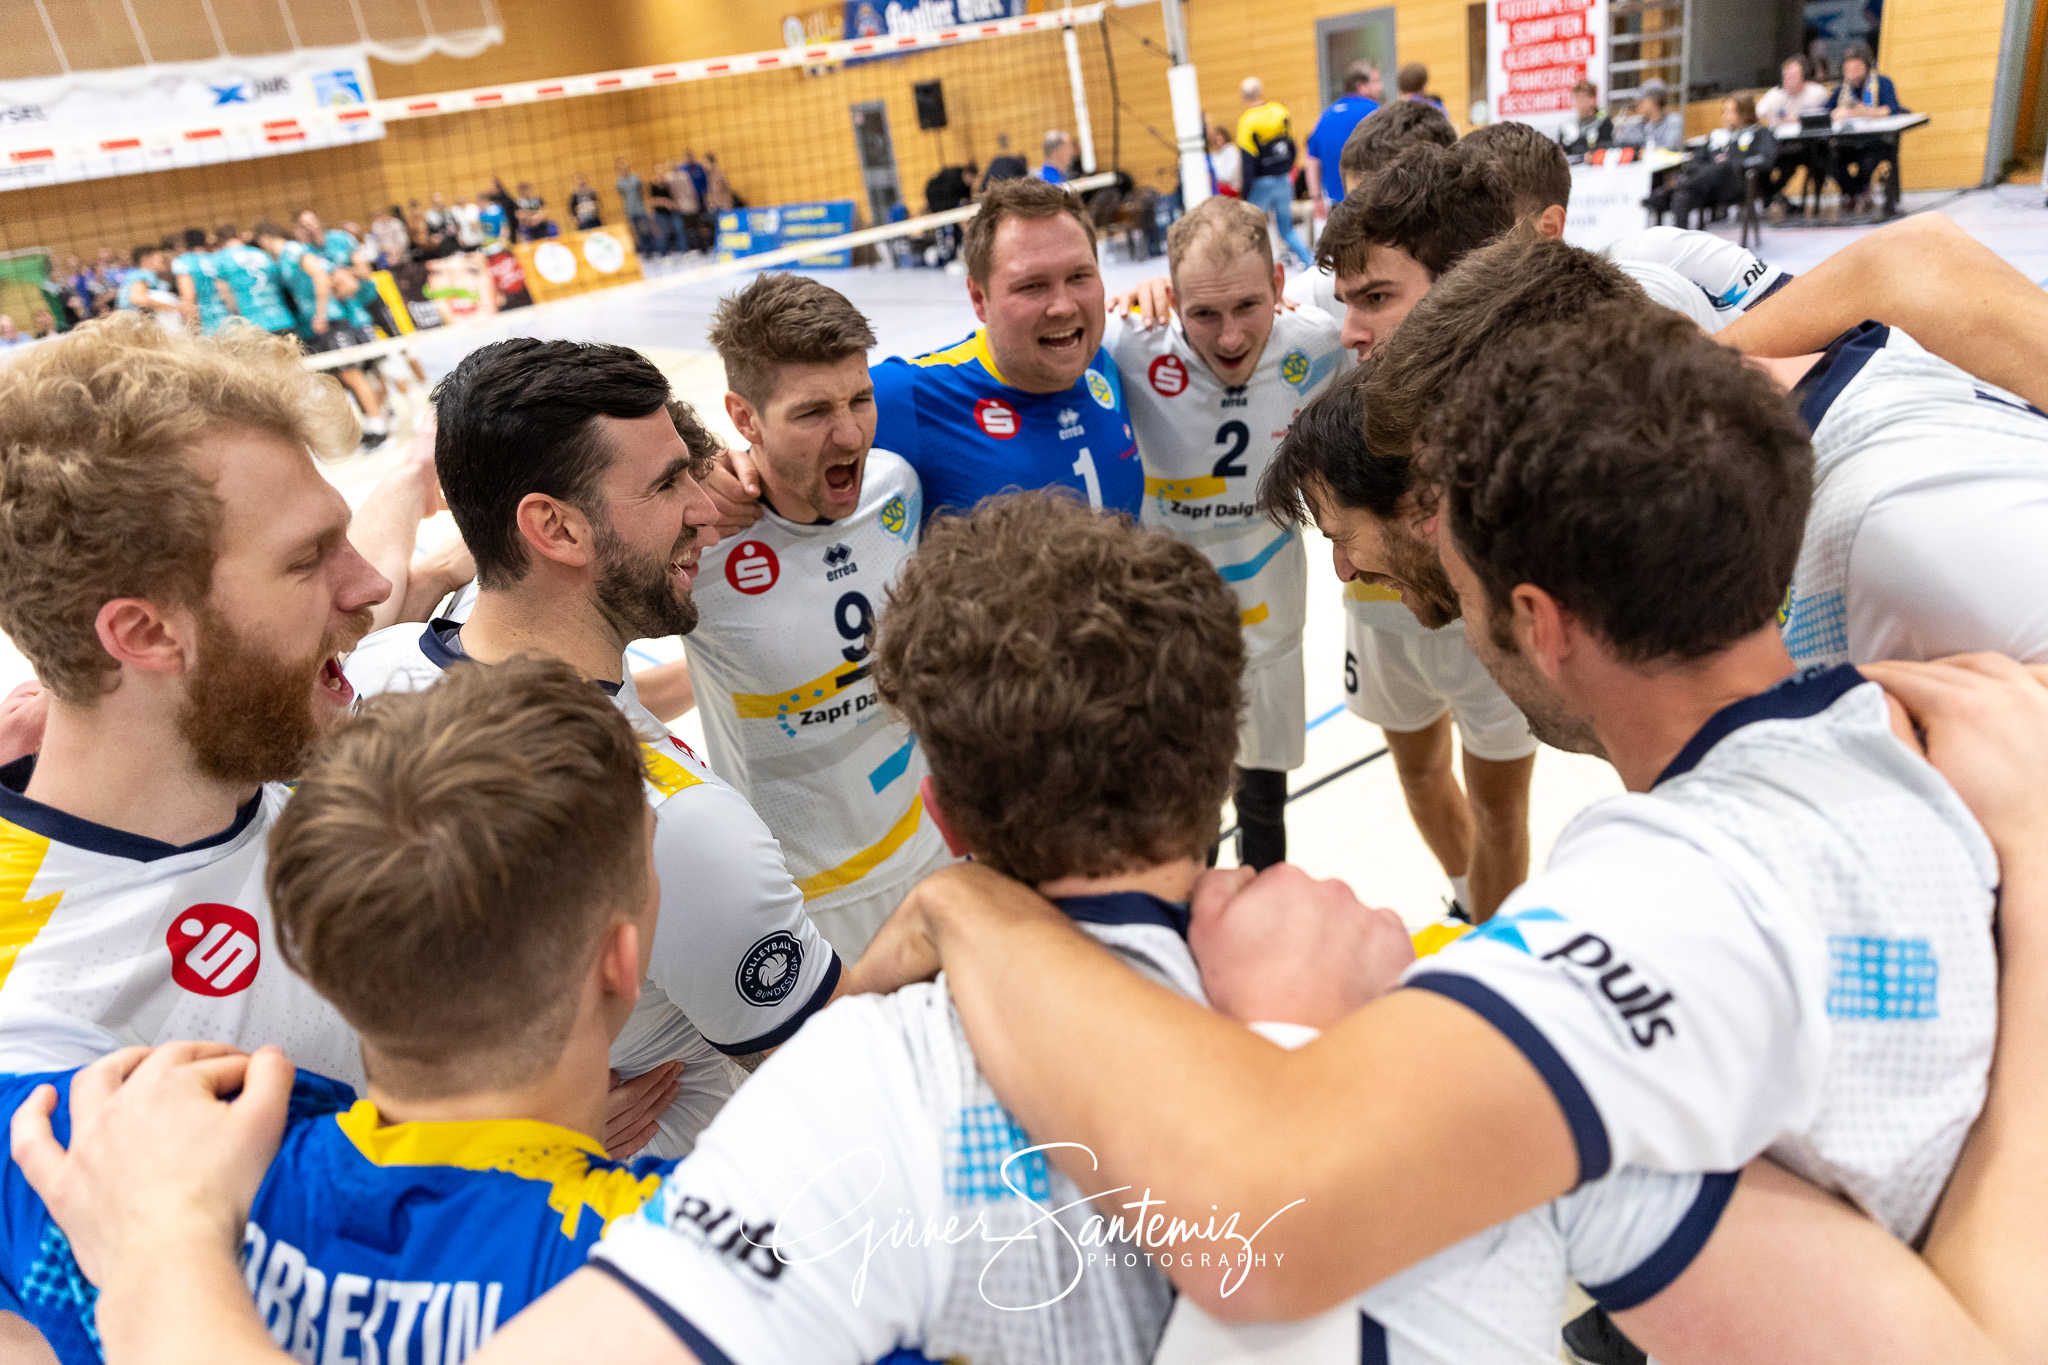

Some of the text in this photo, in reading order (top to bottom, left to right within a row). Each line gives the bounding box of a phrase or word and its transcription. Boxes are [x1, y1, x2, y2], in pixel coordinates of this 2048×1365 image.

[1212, 419, 1250, 478] 2
[1072, 447, 1104, 514] 1
[1171, 500, 1212, 520] Zapf
[834, 590, 878, 663] 9
[799, 700, 851, 726] Zapf
[745, 940, 792, 983] VOLLEYBALL
[755, 955, 799, 999] BUNDESLIGA
[1541, 933, 1675, 1048] puls
